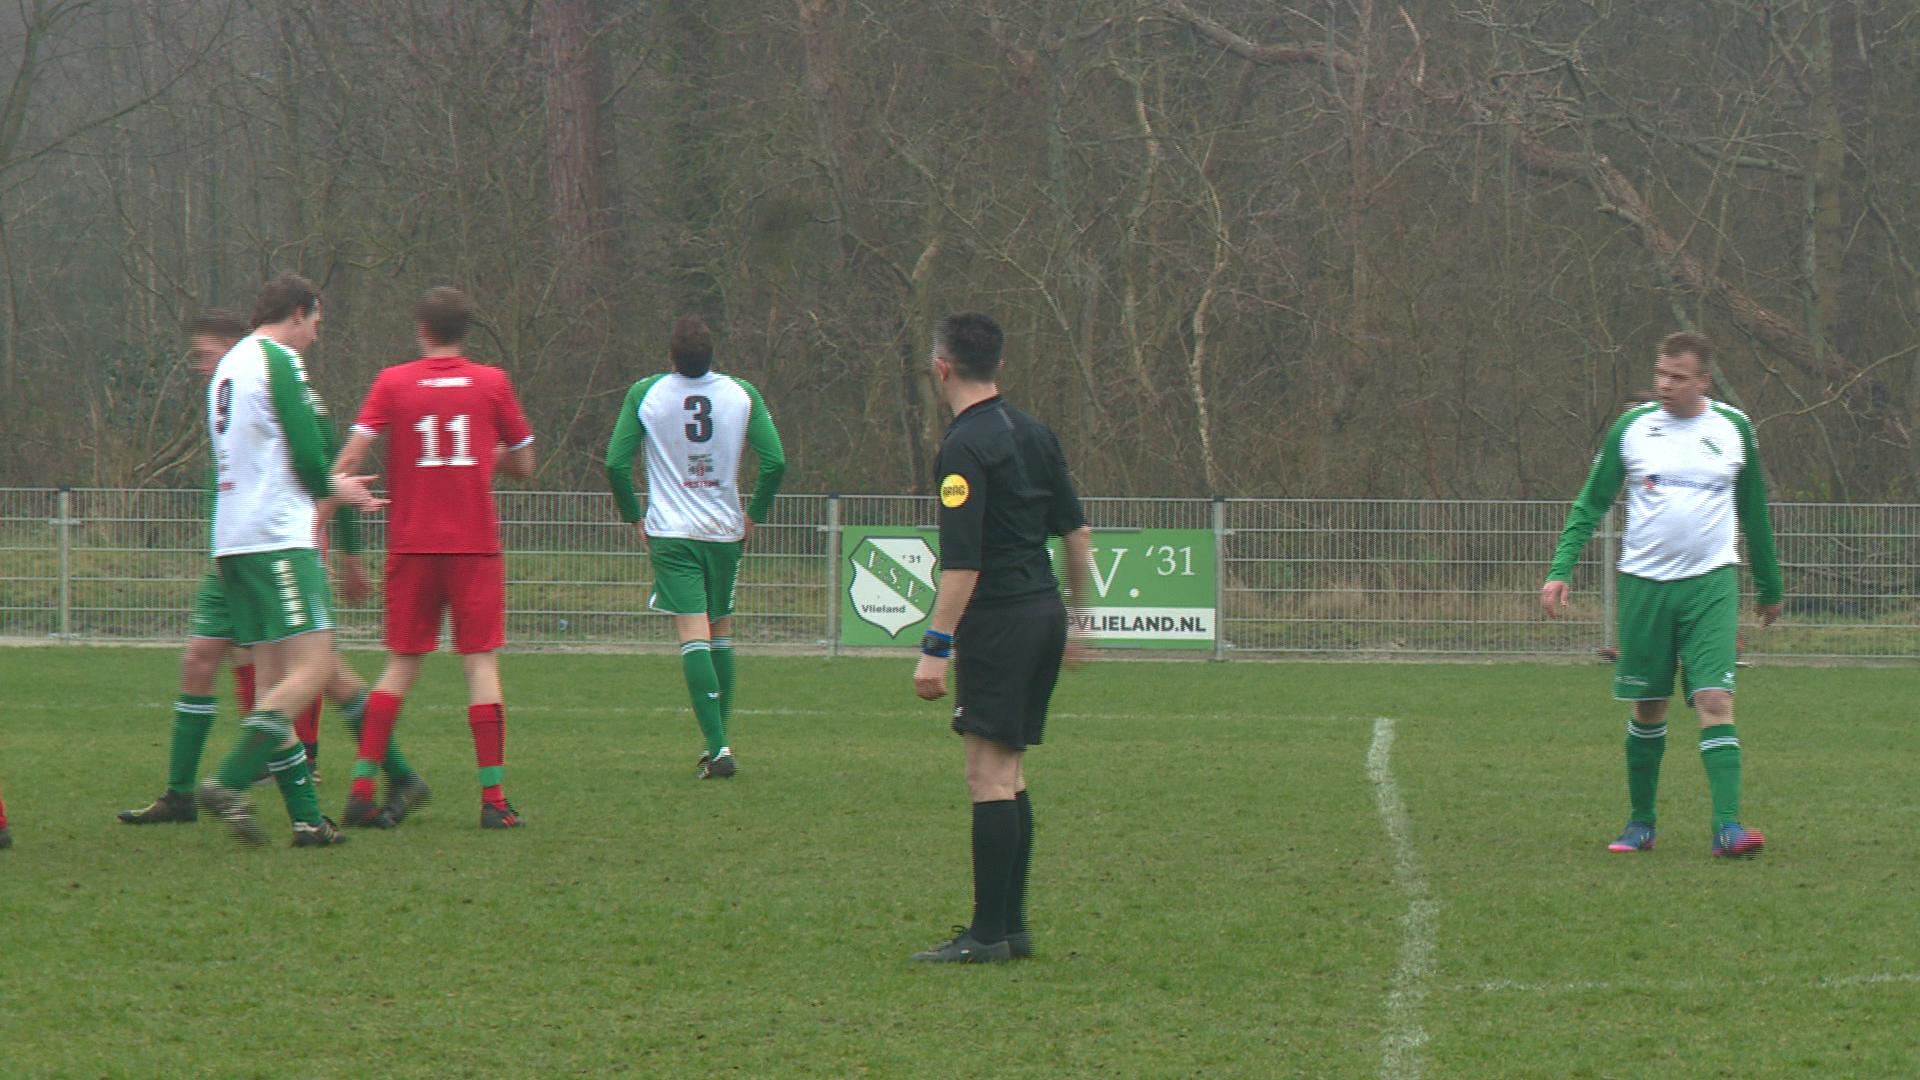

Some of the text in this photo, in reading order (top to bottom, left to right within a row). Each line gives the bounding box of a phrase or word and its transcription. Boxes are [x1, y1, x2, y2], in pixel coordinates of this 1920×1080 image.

[215, 378, 233, 434] 9
[682, 395, 712, 443] 3
[412, 413, 478, 467] 11
[861, 603, 906, 614] Vlieland
